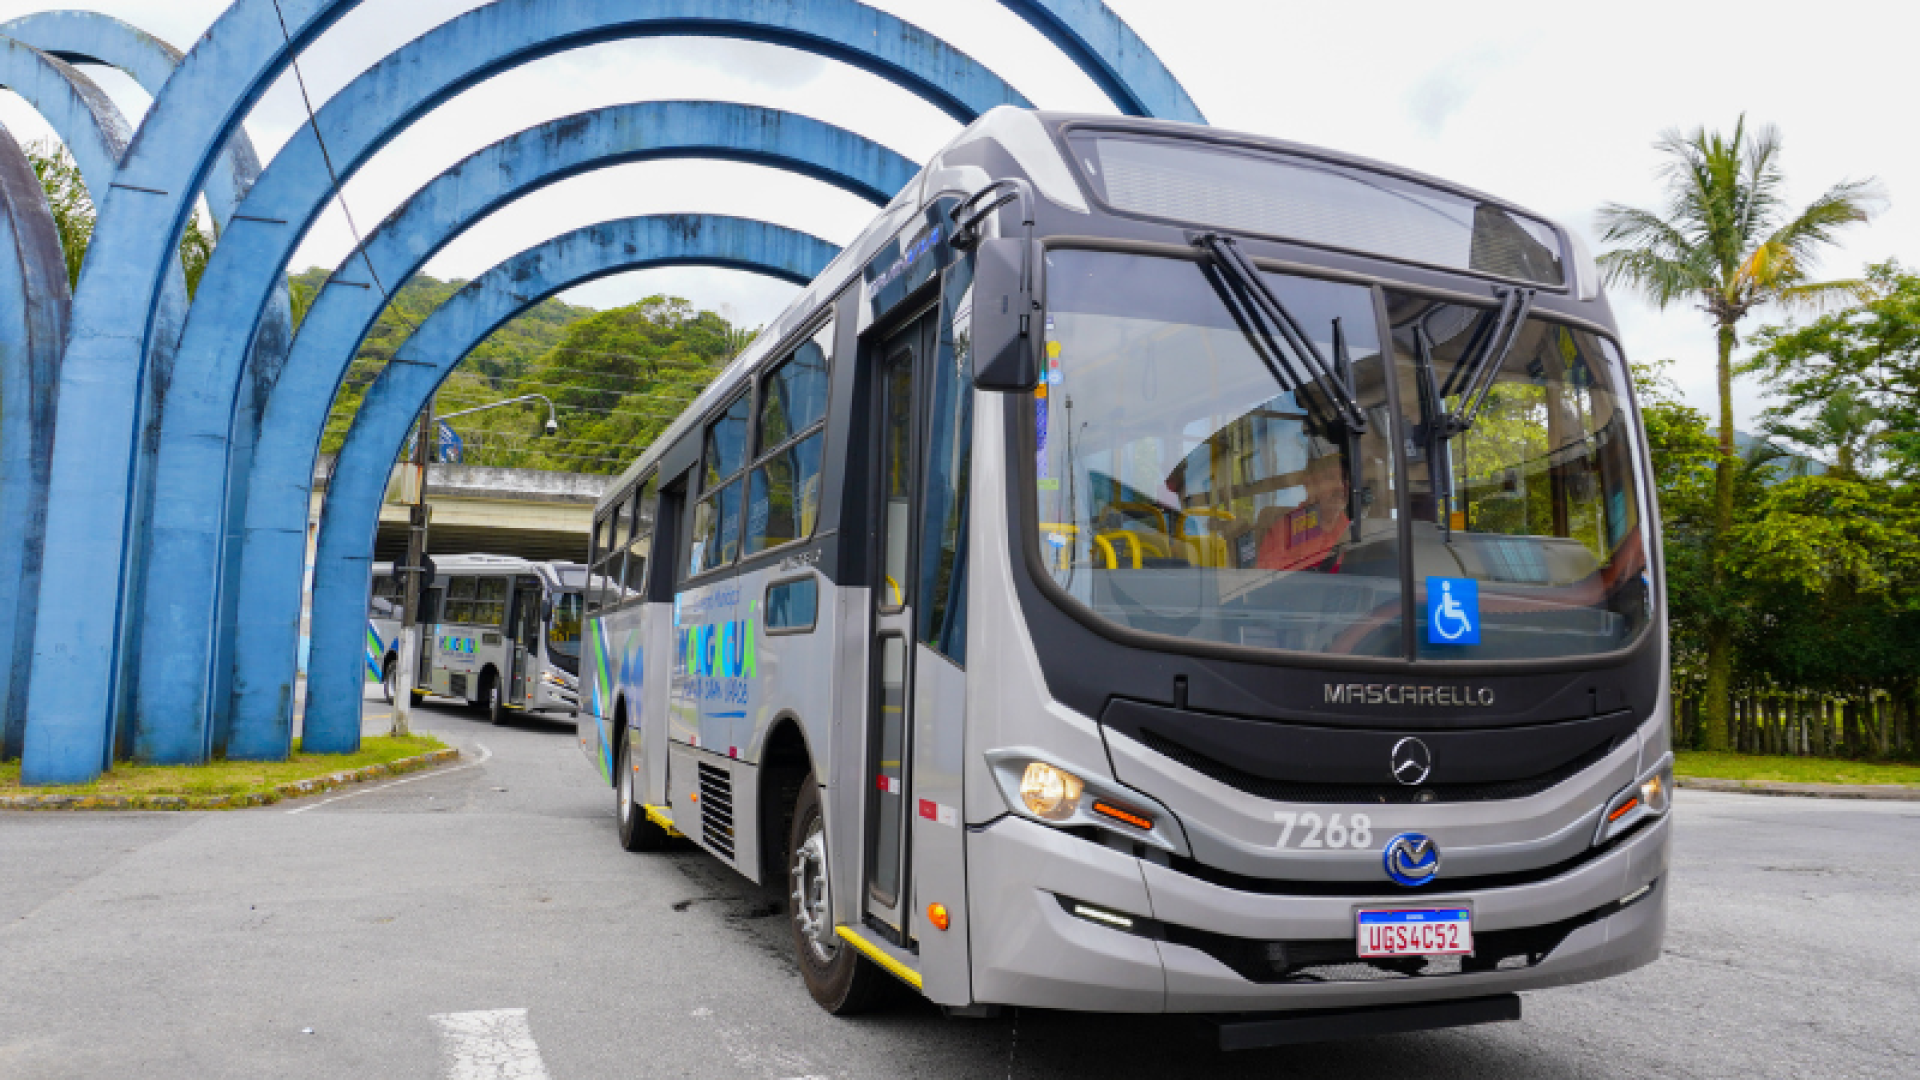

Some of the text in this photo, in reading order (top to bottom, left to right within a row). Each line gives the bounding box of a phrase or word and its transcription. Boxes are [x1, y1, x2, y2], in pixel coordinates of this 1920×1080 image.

[1324, 683, 1495, 706] MASCARELLO
[1273, 811, 1373, 849] 7268
[1368, 923, 1460, 951] UGS4C52
